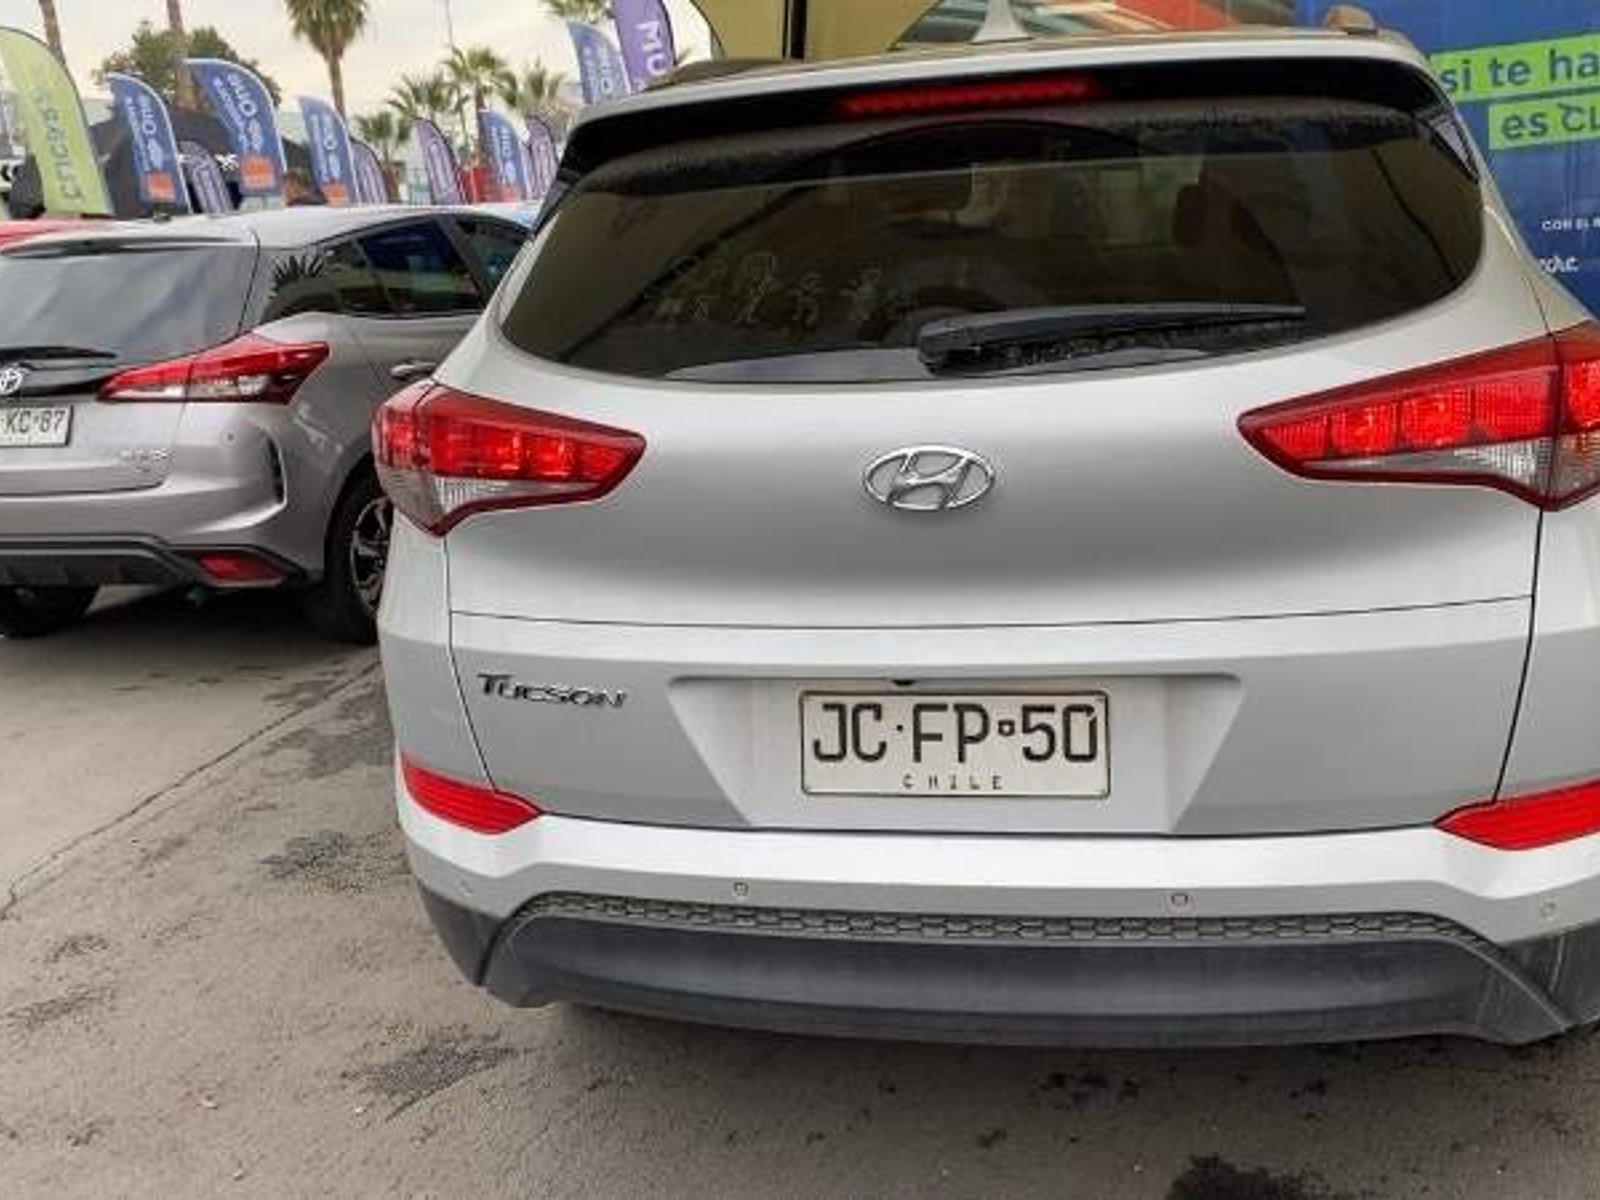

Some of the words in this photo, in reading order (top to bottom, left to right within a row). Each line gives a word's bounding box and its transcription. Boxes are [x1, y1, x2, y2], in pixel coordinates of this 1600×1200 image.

[1440, 58, 1470, 92] si
[1490, 57, 1530, 86] te
[1502, 112, 1548, 140] es
[902, 774, 1003, 790] CHILE
